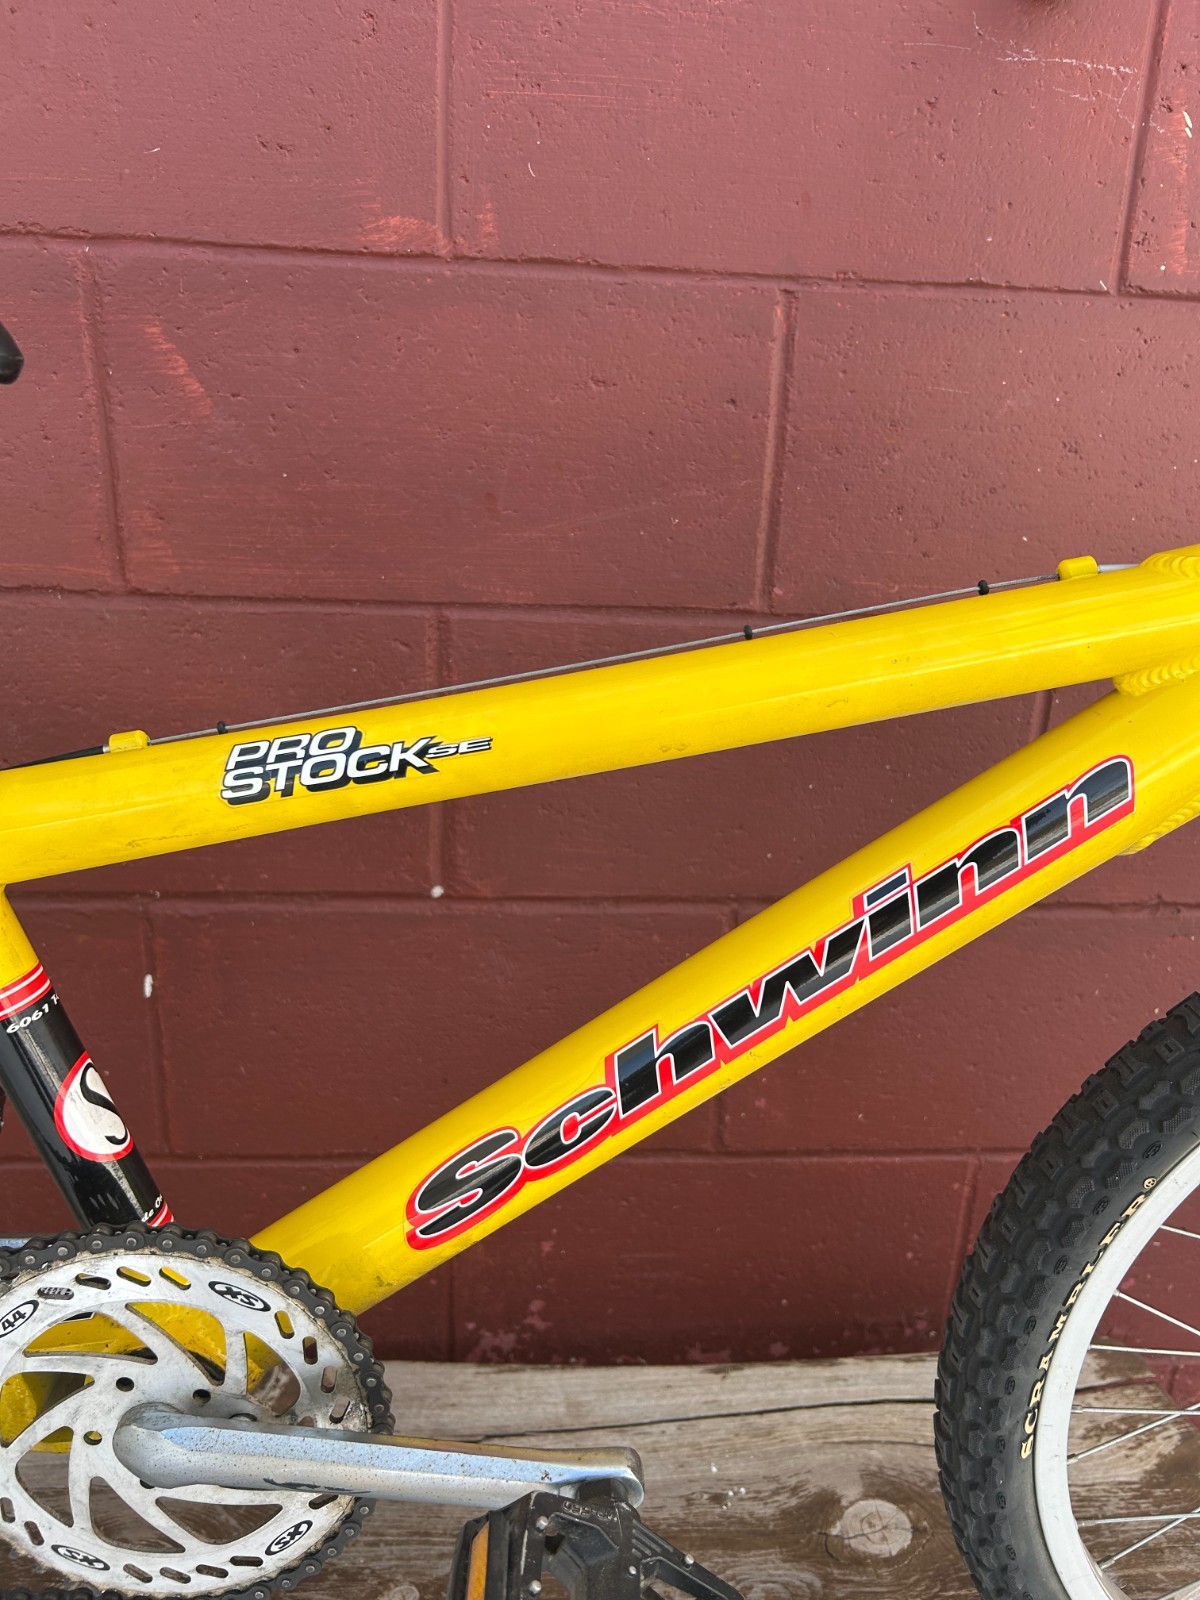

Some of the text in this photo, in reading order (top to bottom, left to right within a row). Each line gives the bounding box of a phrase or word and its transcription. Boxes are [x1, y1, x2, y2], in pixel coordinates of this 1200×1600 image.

[220, 736, 492, 804] STOCK SE
[225, 725, 361, 770] PRO
[6, 1003, 49, 1034] 6061
[408, 756, 1133, 1248] Schwinn
[1, 1310, 27, 1331] 44
